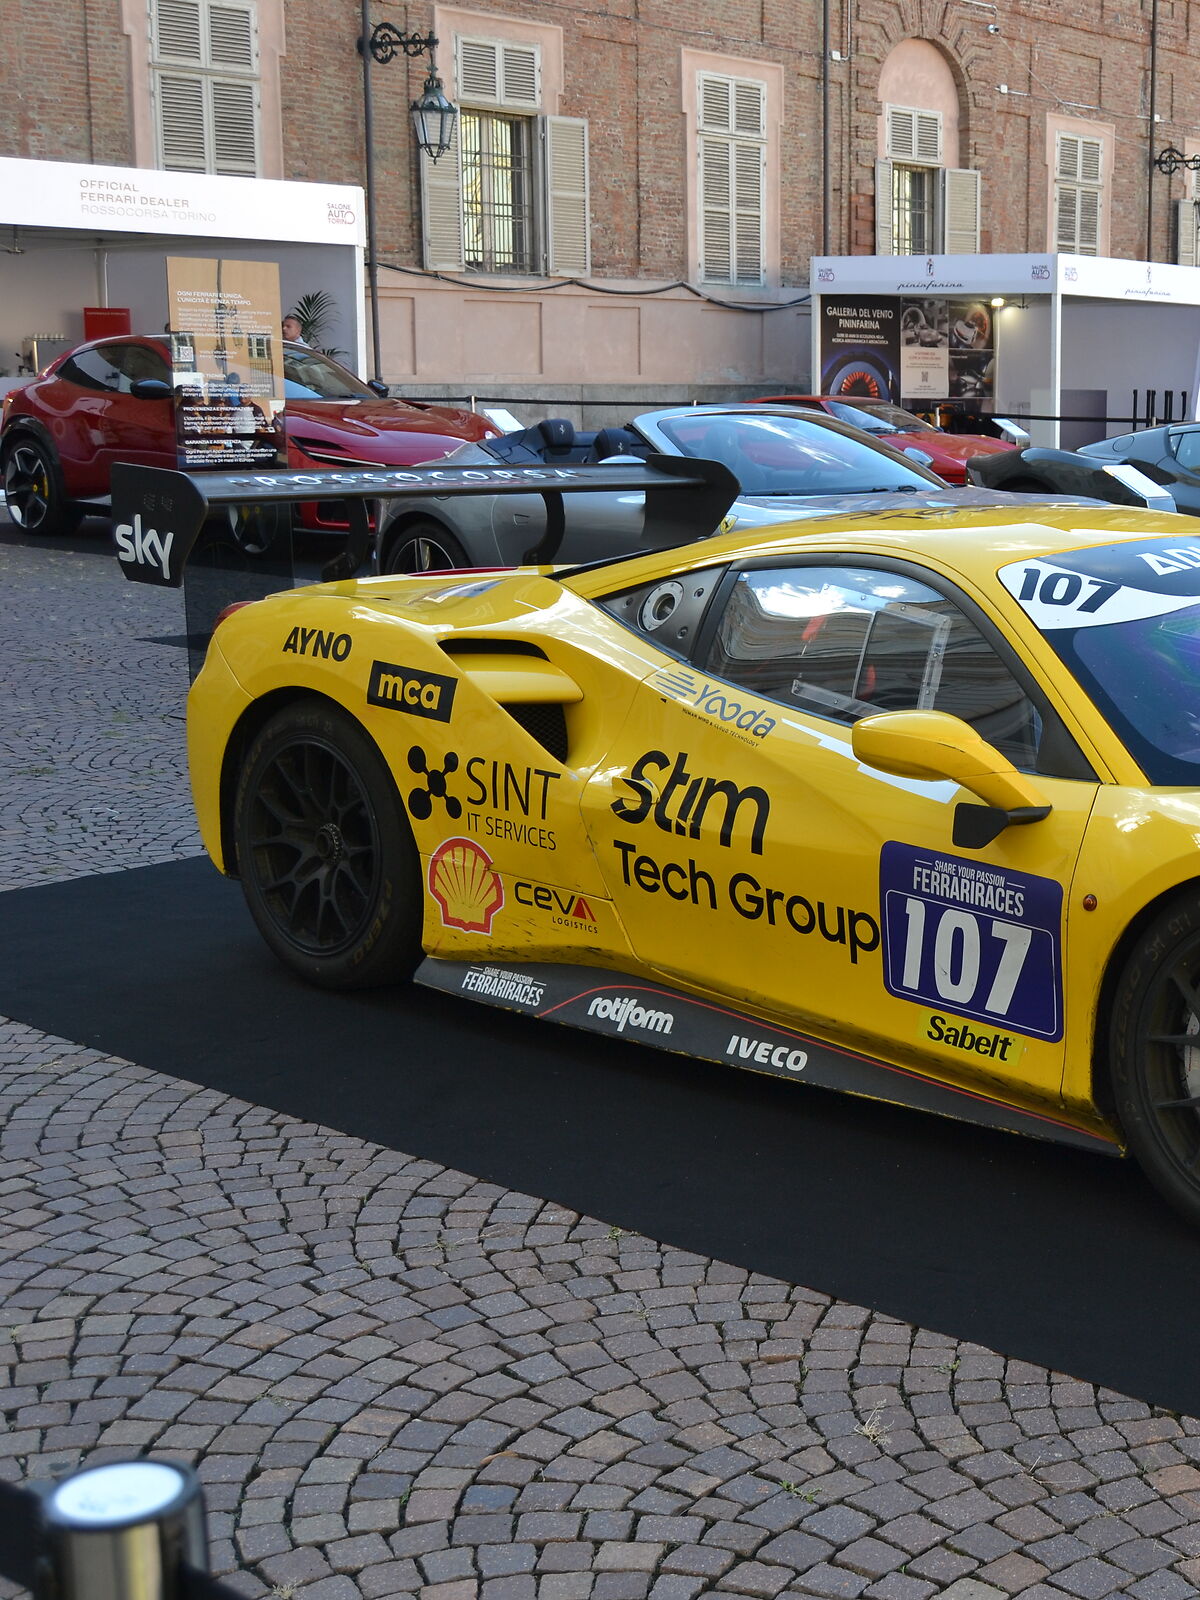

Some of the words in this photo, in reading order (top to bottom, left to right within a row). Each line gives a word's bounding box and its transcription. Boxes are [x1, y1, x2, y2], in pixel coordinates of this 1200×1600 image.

[80, 179, 139, 192] OFFICIAL
[80, 192, 136, 205] FERRARI
[140, 196, 189, 208] DEALER
[81, 205, 168, 218] ROSSOCORSA
[172, 210, 217, 222] TORINO
[328, 210, 356, 225] AUTO
[896, 280, 965, 290] pininfarina
[1125, 287, 1172, 297] pininfarina
[826, 306, 858, 317] GALLERIA
[858, 308, 871, 318] DEL
[872, 309, 894, 319] VENTO
[838, 318, 880, 330] PININFARINA
[253, 468, 580, 488] ROSSOCORSA
[115, 513, 174, 580] sky
[1018, 568, 1123, 614] 107
[282, 626, 353, 662] AYNO
[378, 673, 442, 711] mca
[729, 730, 760, 748] TECHNOLOGY
[466, 756, 561, 821] SINT
[610, 750, 770, 856] Stim
[467, 812, 481, 833] IT
[485, 815, 557, 851] SERVICES
[913, 866, 1025, 917] FERRARIRACES
[934, 860, 957, 875] SHARE
[957, 865, 976, 879] YOUR
[976, 871, 1006, 888] PASSION
[613, 839, 718, 910] Tech
[728, 872, 880, 965] Group
[552, 916, 598, 934] LOGISTICS
[902, 897, 1033, 1016] 107
[461, 970, 545, 1007] FERRARIRACES
[482, 966, 501, 978] SHARE
[500, 970, 513, 980] YOUR
[513, 973, 534, 985] PASSION
[587, 996, 675, 1034] rotiform
[725, 1035, 808, 1072] IVECO
[926, 1015, 1013, 1062] Sabelt
